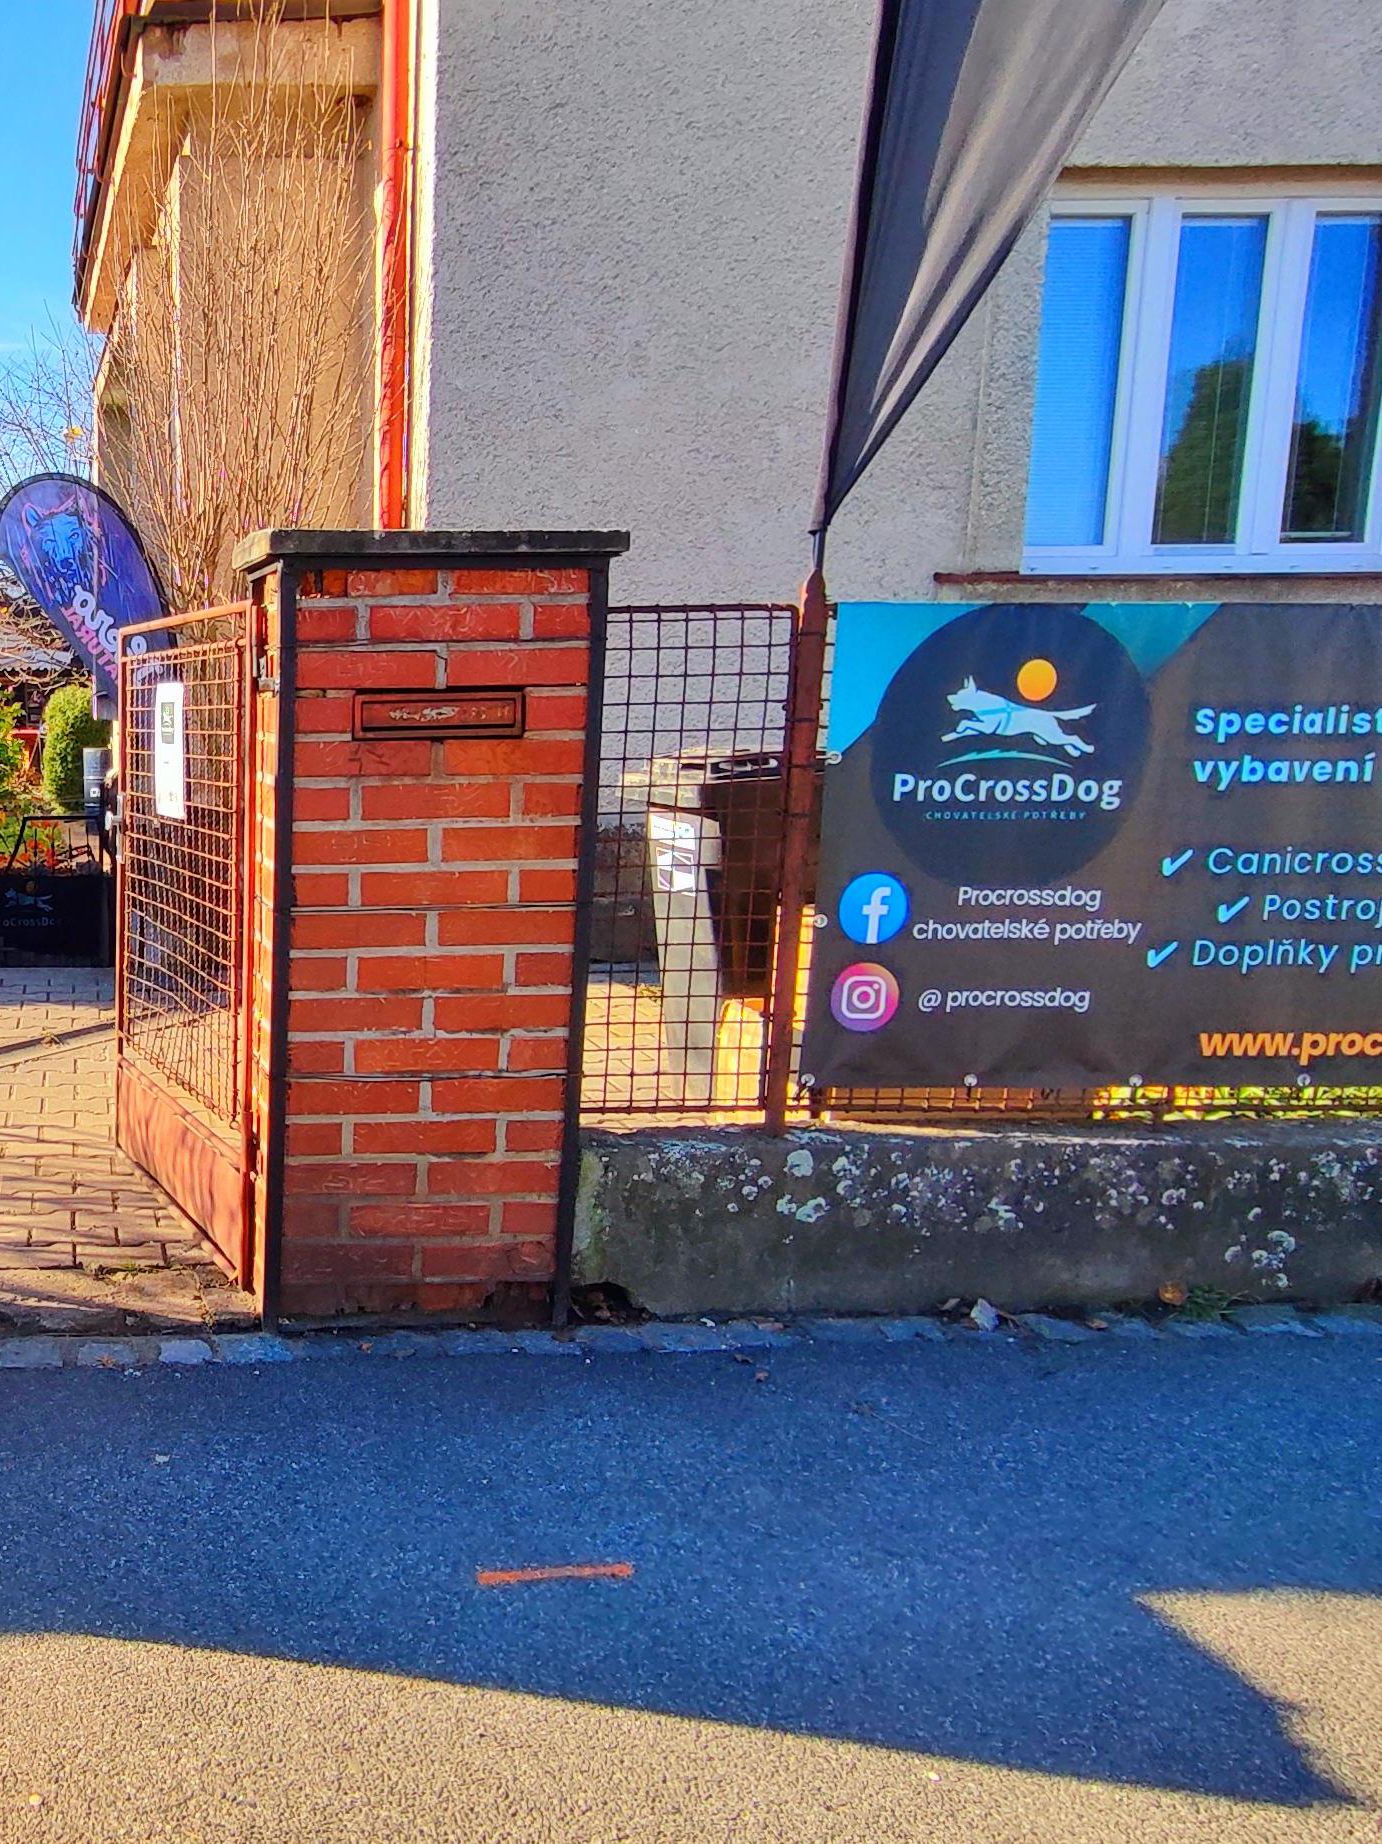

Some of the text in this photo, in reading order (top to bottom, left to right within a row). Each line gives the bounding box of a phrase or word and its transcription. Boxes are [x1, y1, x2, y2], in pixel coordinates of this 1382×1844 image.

[1193, 752, 1377, 792] vybavení
[892, 772, 1123, 811] ProCrossDog
[957, 885, 1102, 912] Procrossdog
[912, 918, 1143, 946] chovatelské potřeby
[1192, 938, 1339, 975] Doplňky
[945, 987, 1091, 1013] procrossdog
